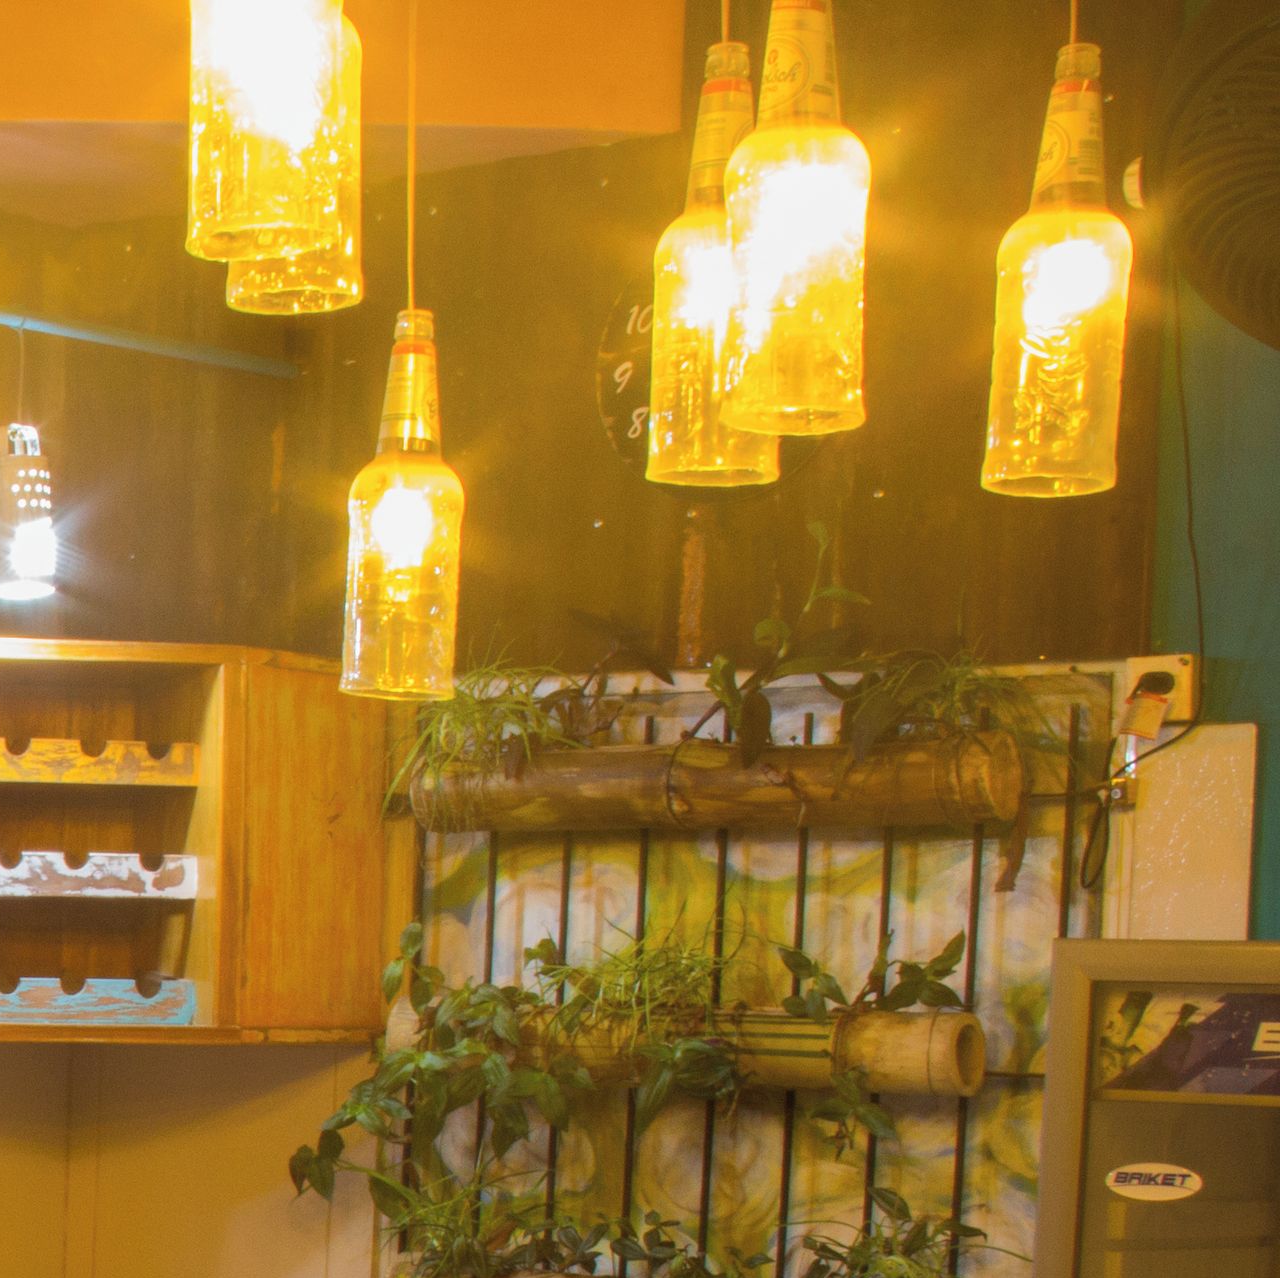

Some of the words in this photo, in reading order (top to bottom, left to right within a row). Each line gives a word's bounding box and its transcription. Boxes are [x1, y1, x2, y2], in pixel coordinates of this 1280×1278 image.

[614, 361, 634, 394] 9
[628, 406, 649, 439] 8
[1114, 1171, 1191, 1186] BRIKET
